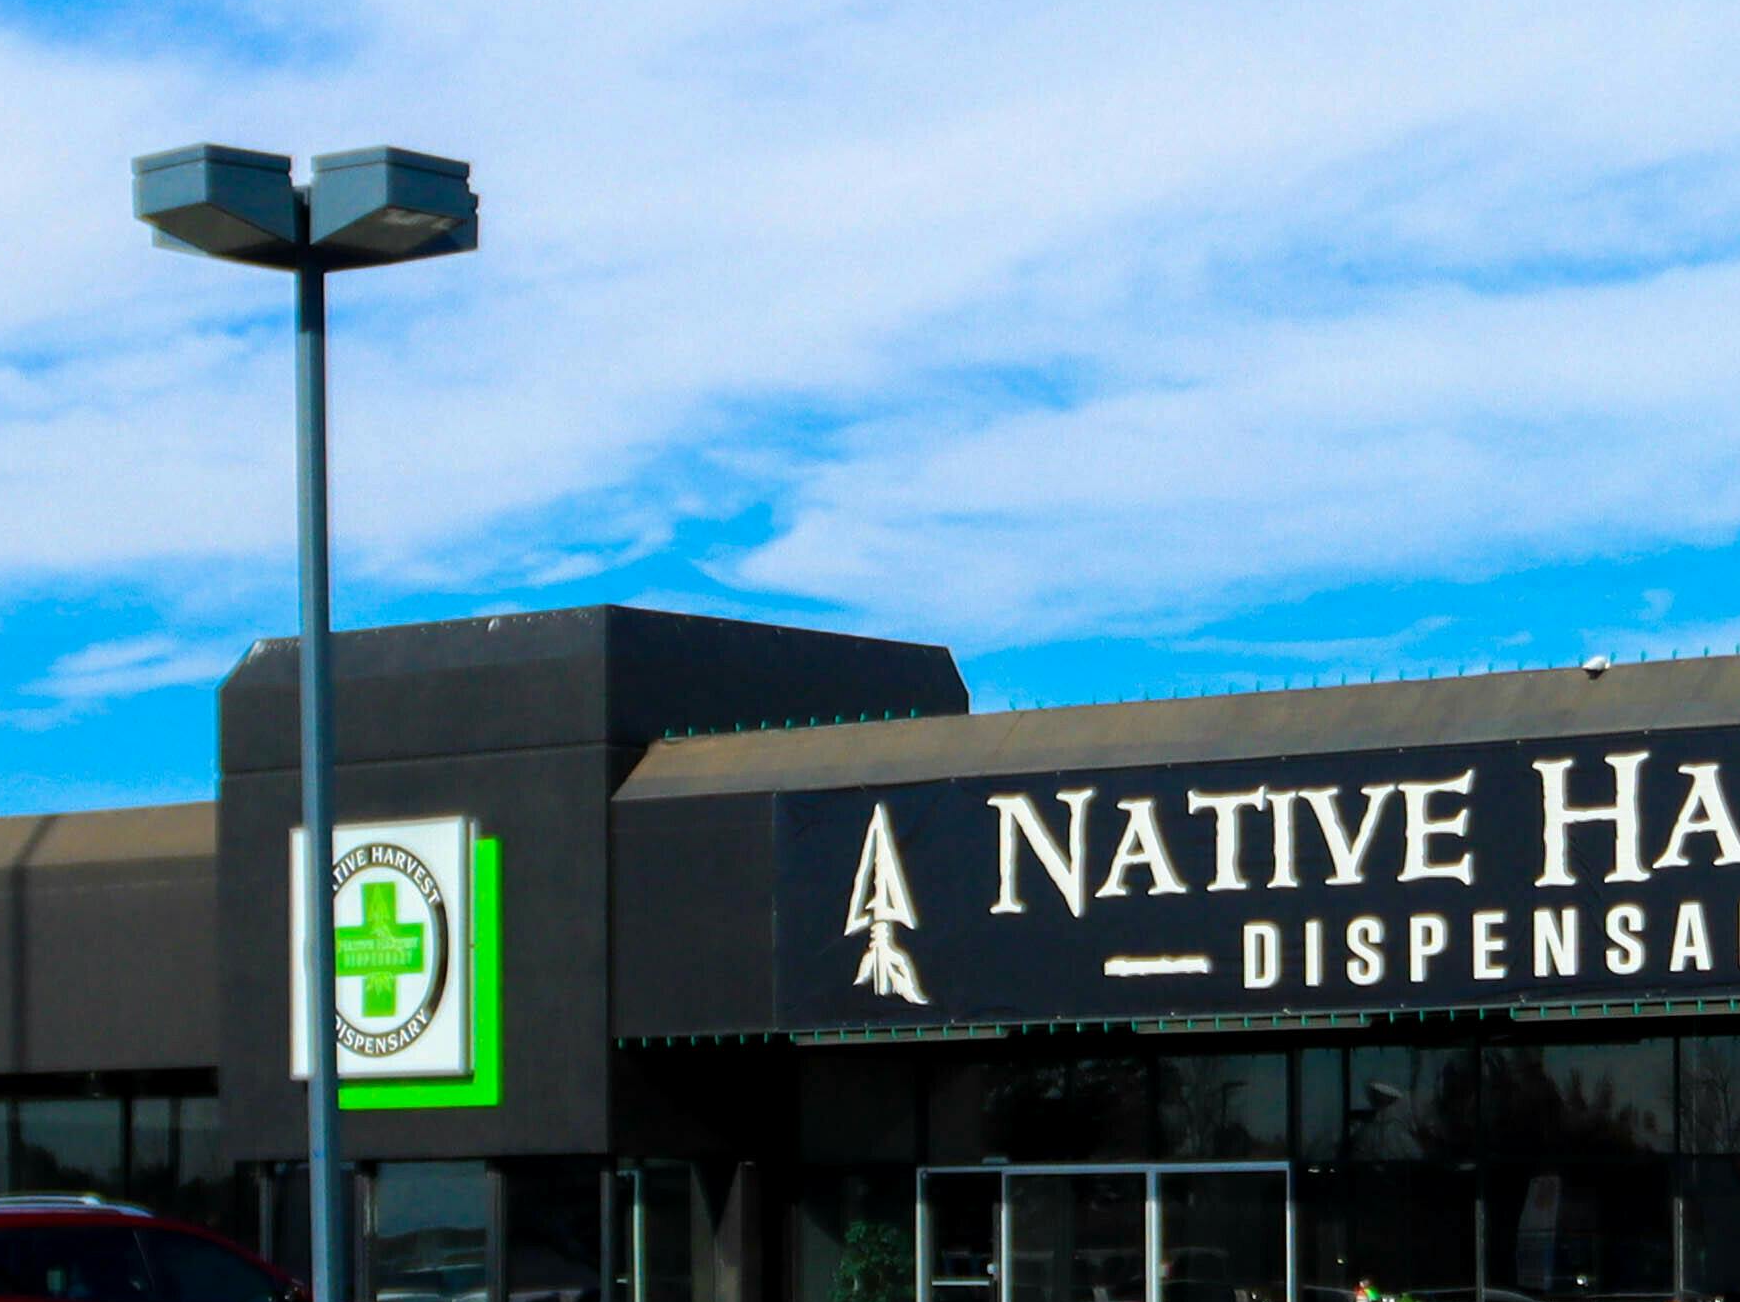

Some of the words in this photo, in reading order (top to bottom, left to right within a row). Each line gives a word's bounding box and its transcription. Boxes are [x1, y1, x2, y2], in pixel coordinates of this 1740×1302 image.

[333, 849, 367, 891] TIVE
[371, 846, 442, 905] HARVEST
[988, 769, 1475, 919] NATIVE
